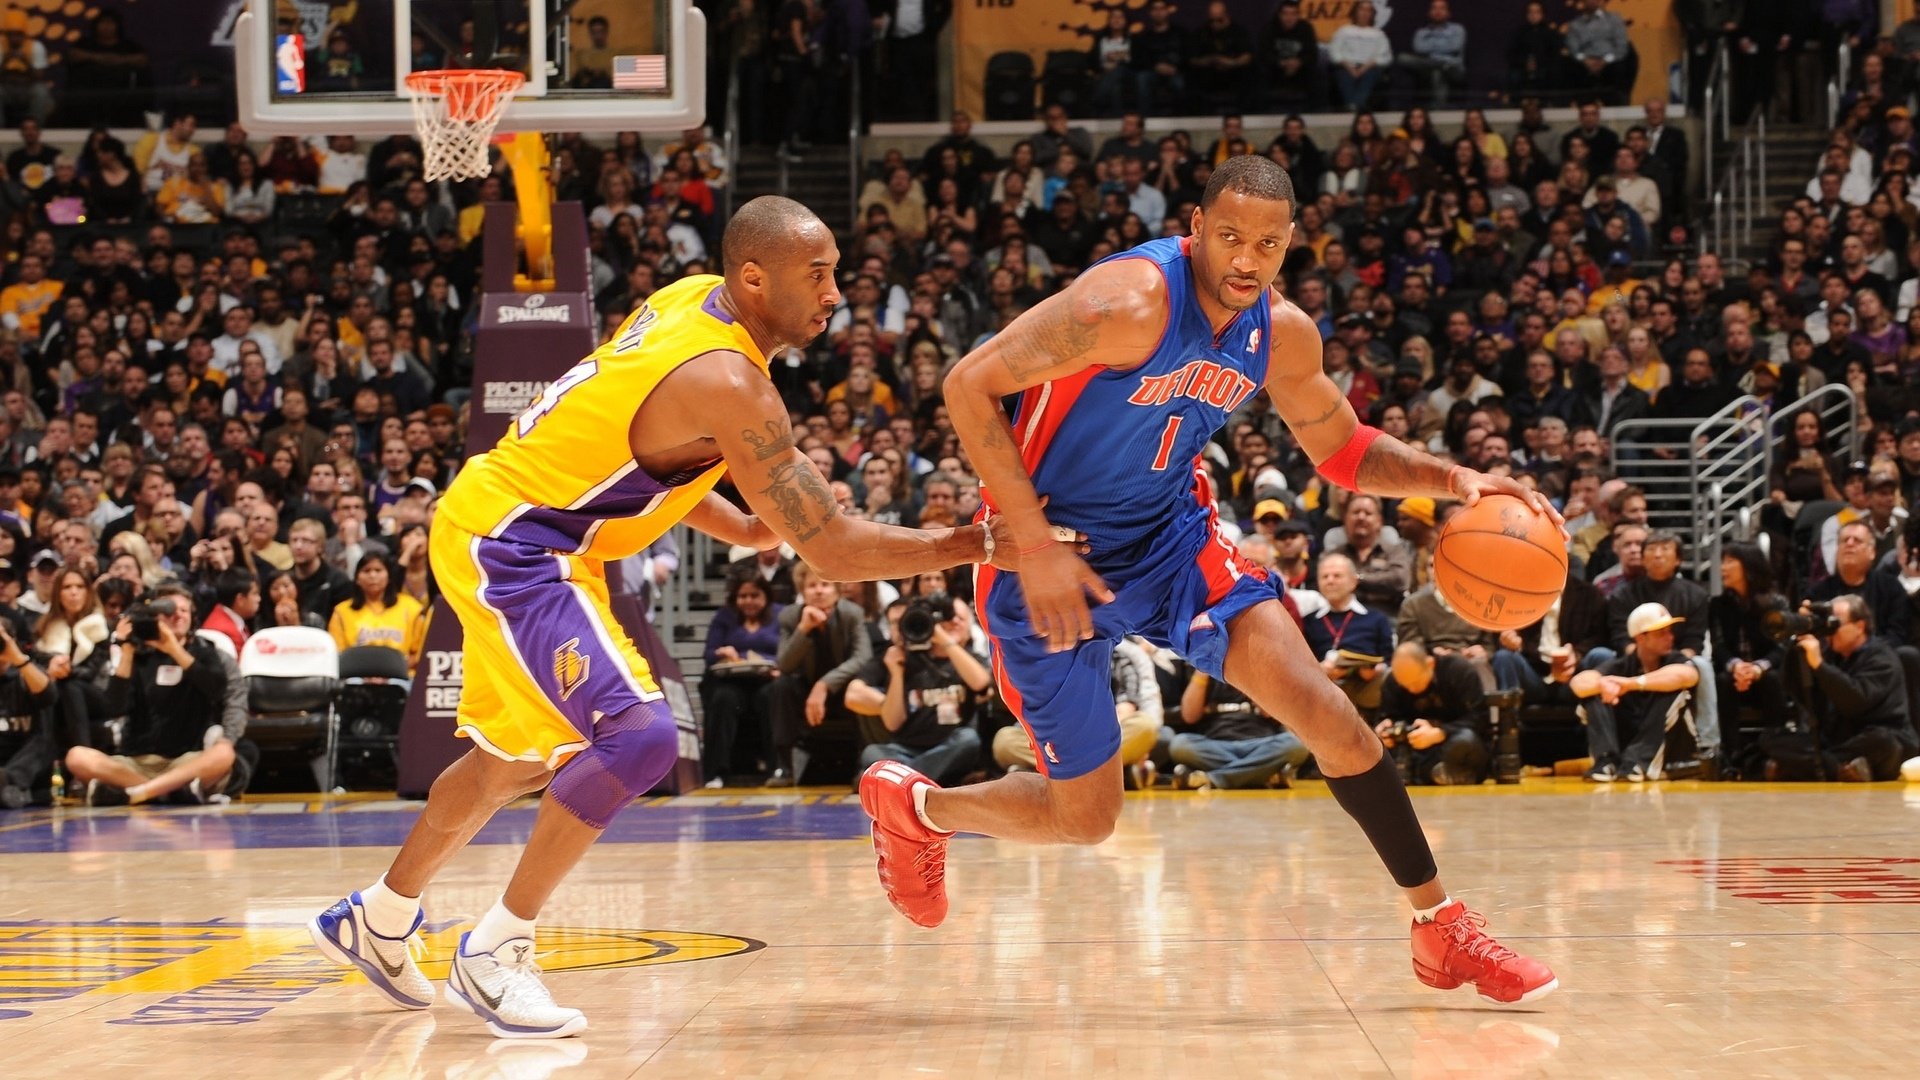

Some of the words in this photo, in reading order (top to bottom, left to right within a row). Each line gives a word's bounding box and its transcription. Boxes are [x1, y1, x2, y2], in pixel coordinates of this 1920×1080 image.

[498, 304, 570, 323] SPALDING
[1127, 360, 1257, 413] DETROIT
[1151, 415, 1184, 471] 1
